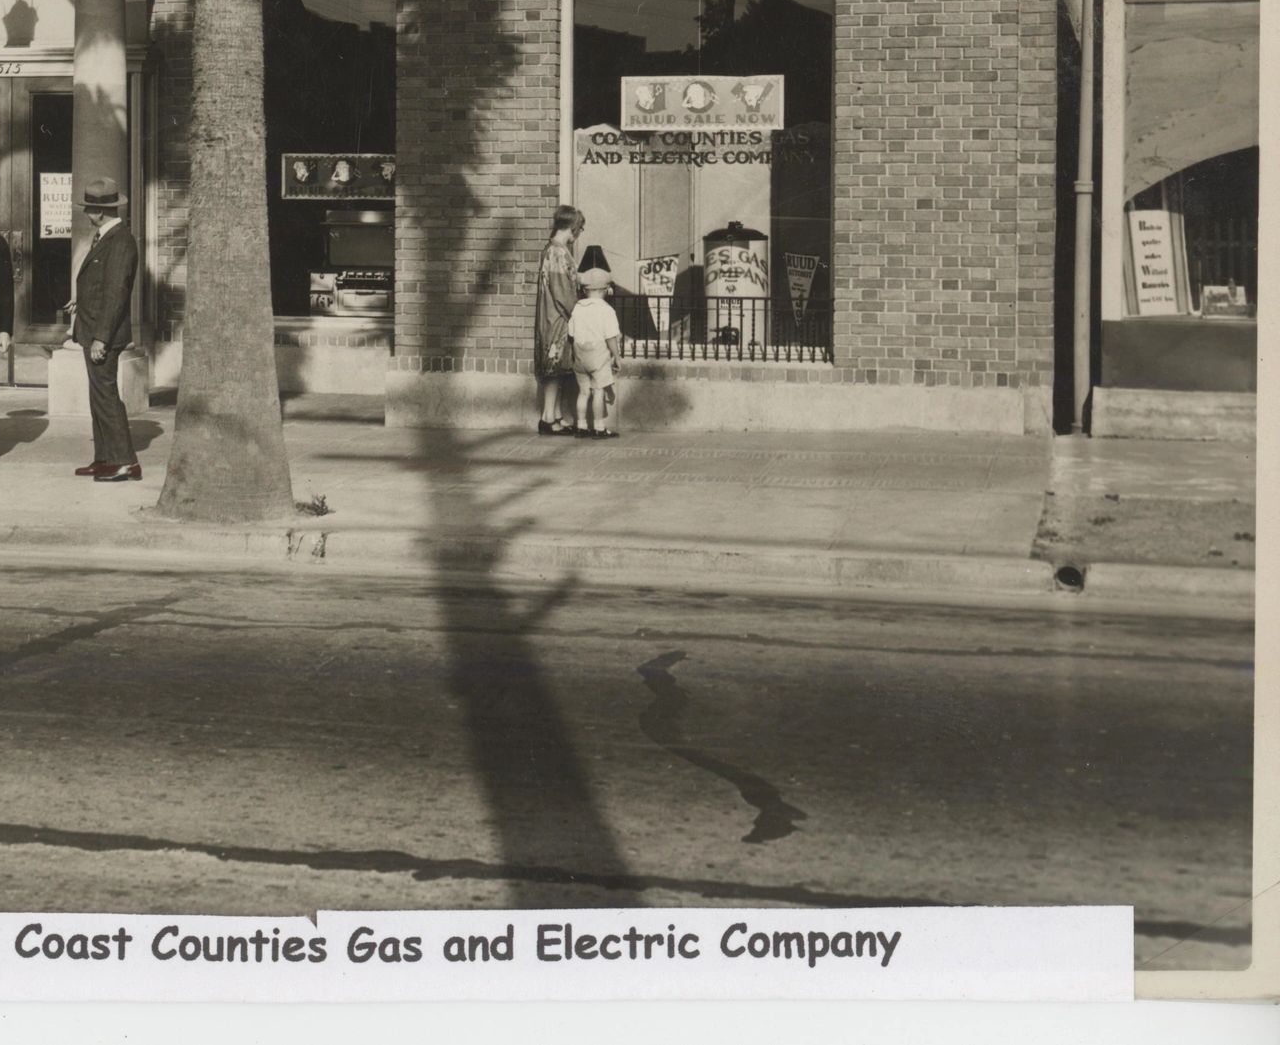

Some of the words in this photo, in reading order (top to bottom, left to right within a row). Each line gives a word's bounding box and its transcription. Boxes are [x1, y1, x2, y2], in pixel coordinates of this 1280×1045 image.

[629, 114, 677, 125] RUUD
[683, 114, 726, 125] SALE
[735, 114, 777, 125] NOW
[591, 131, 651, 146] COAST
[661, 130, 762, 150] COUNTIES
[770, 128, 810, 146] GAS
[582, 149, 623, 167] AND
[629, 150, 717, 168] ELECTRIC
[43, 193, 72, 203] RUU
[644, 259, 674, 275] JOY
[785, 254, 816, 270] RUUD
